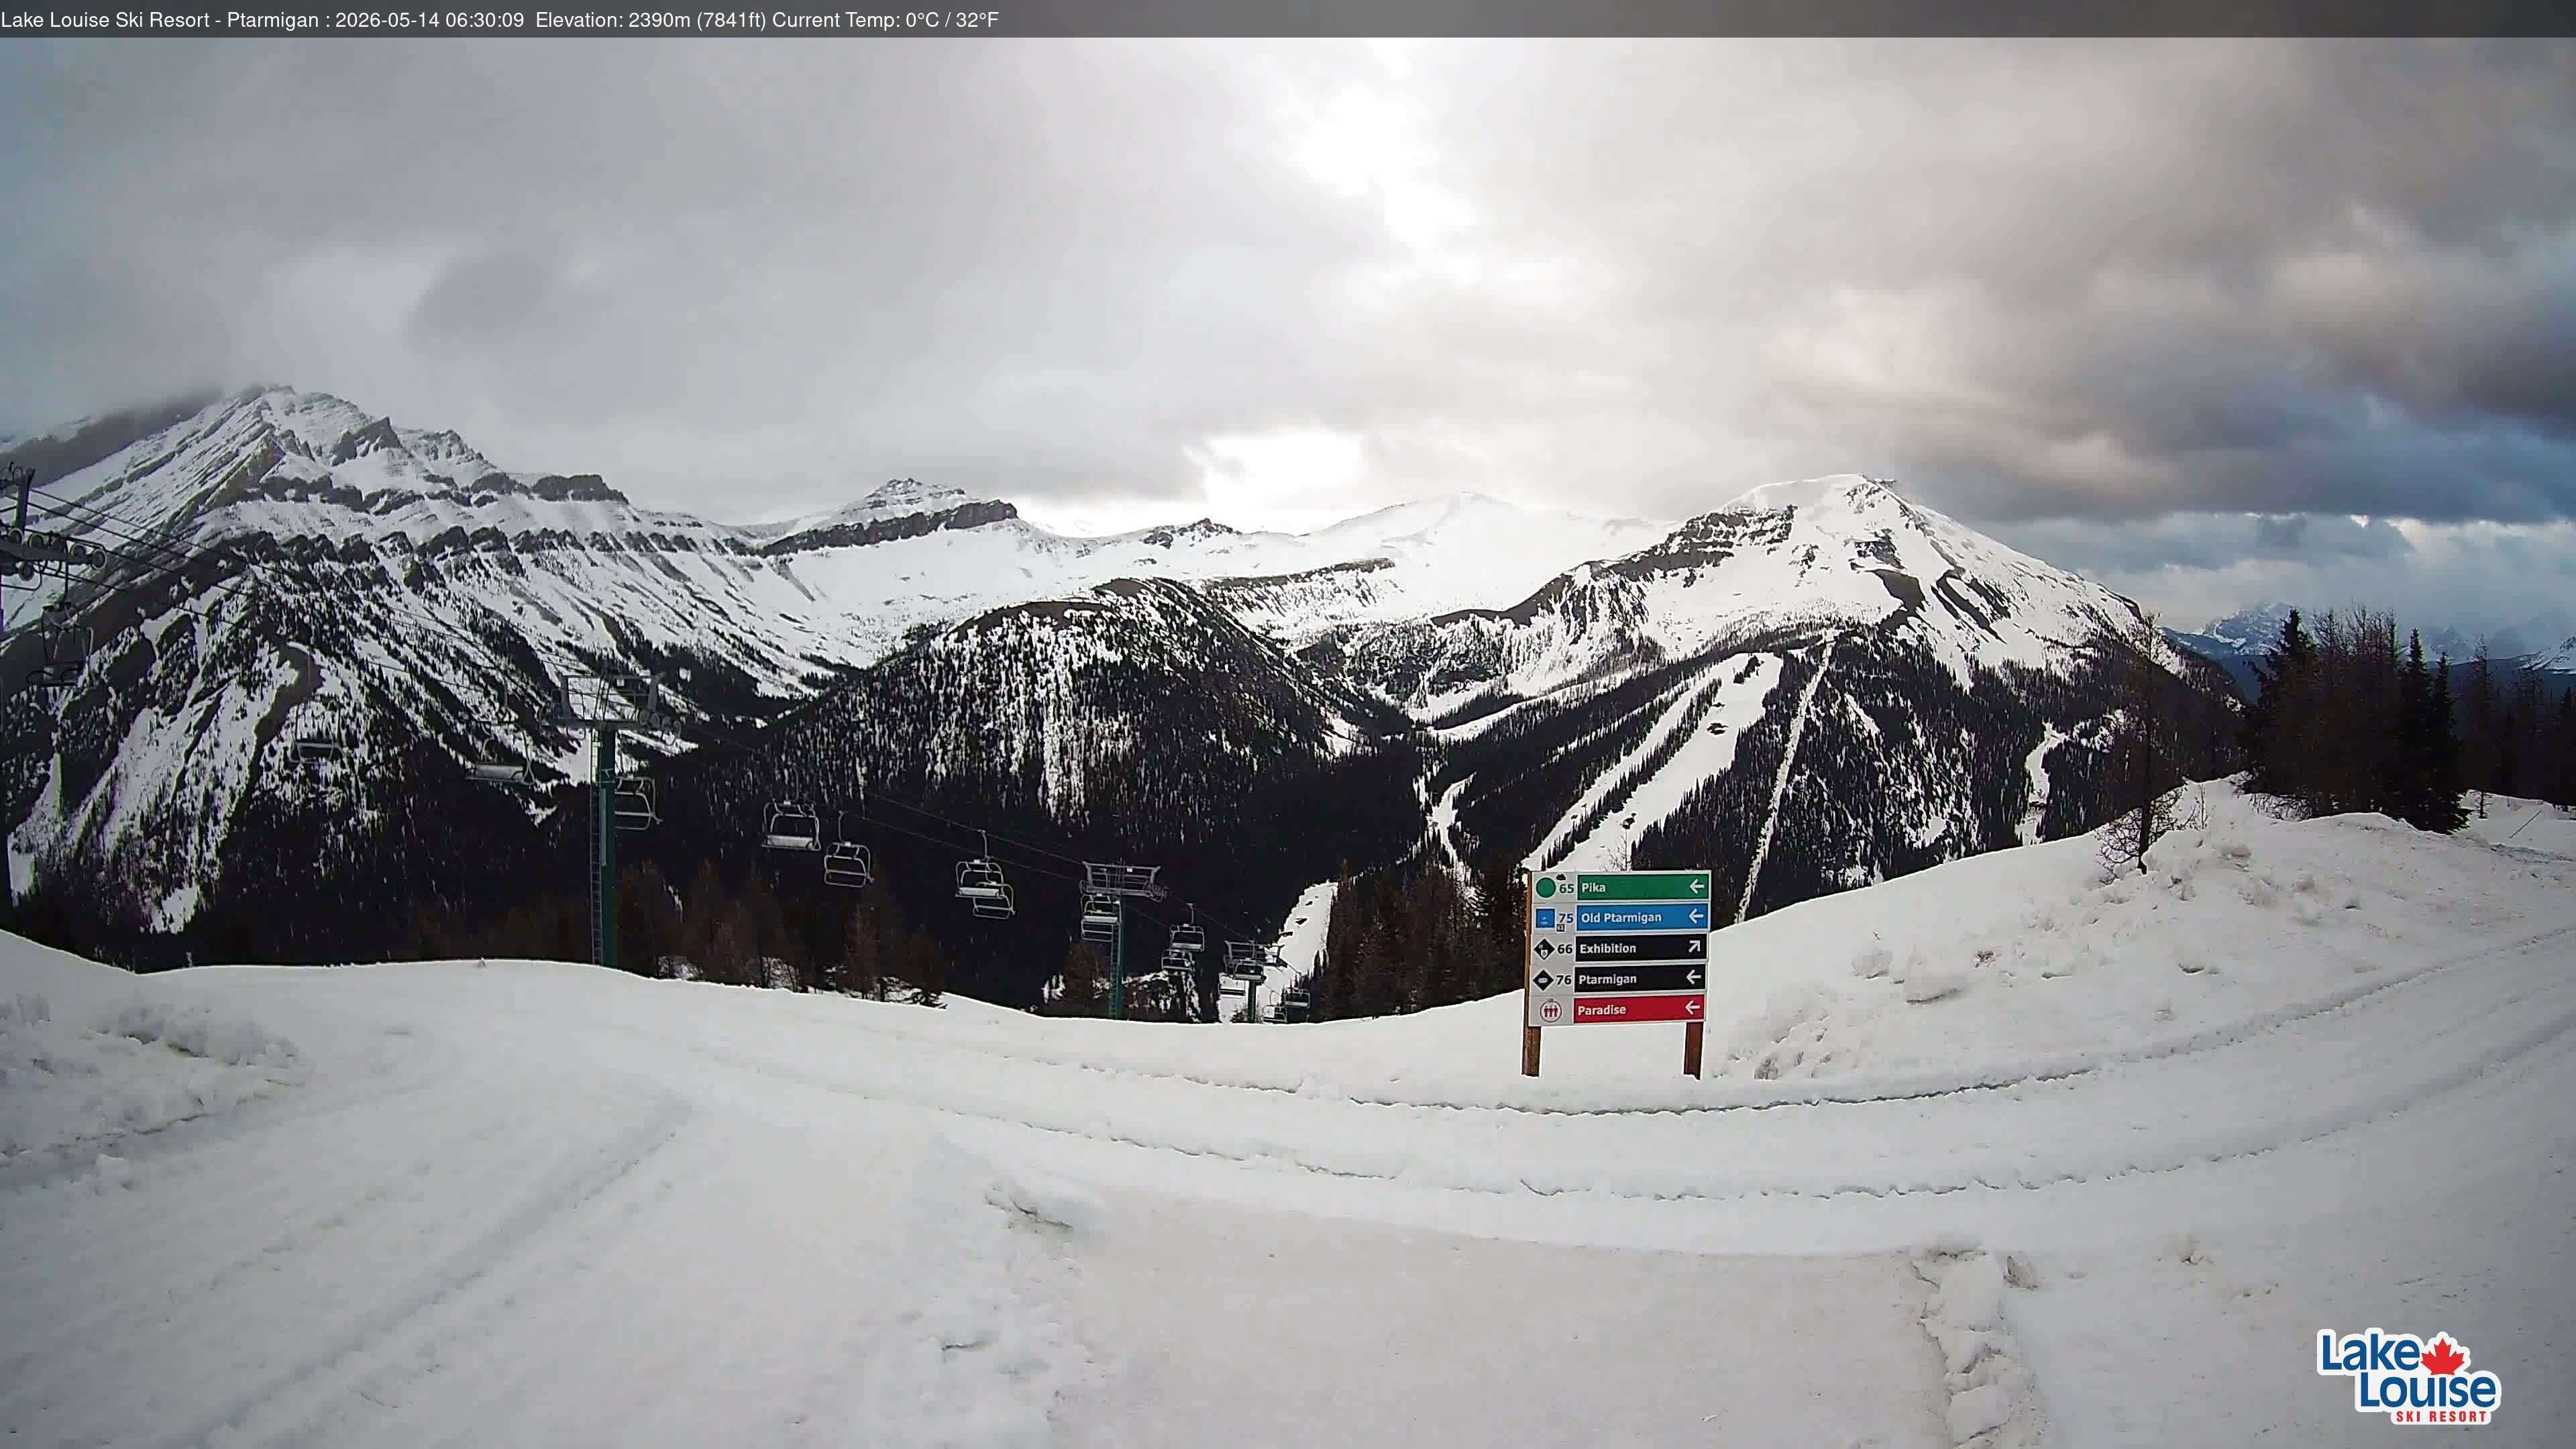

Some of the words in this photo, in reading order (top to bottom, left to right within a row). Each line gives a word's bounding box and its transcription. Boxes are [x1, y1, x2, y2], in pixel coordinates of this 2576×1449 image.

[1559, 883, 1574, 894] 65
[1581, 882, 1606, 893] Pika
[1558, 913, 1574, 923] 75
[1581, 912, 1600, 922] Old
[1604, 911, 1662, 924] Ptarmigan
[1557, 944, 1573, 954] 66
[1580, 942, 1636, 954] Exhibition
[1556, 975, 1572, 985] 76
[1578, 973, 1637, 986] Ptarmigan
[1578, 1005, 1626, 1016] Paradise
